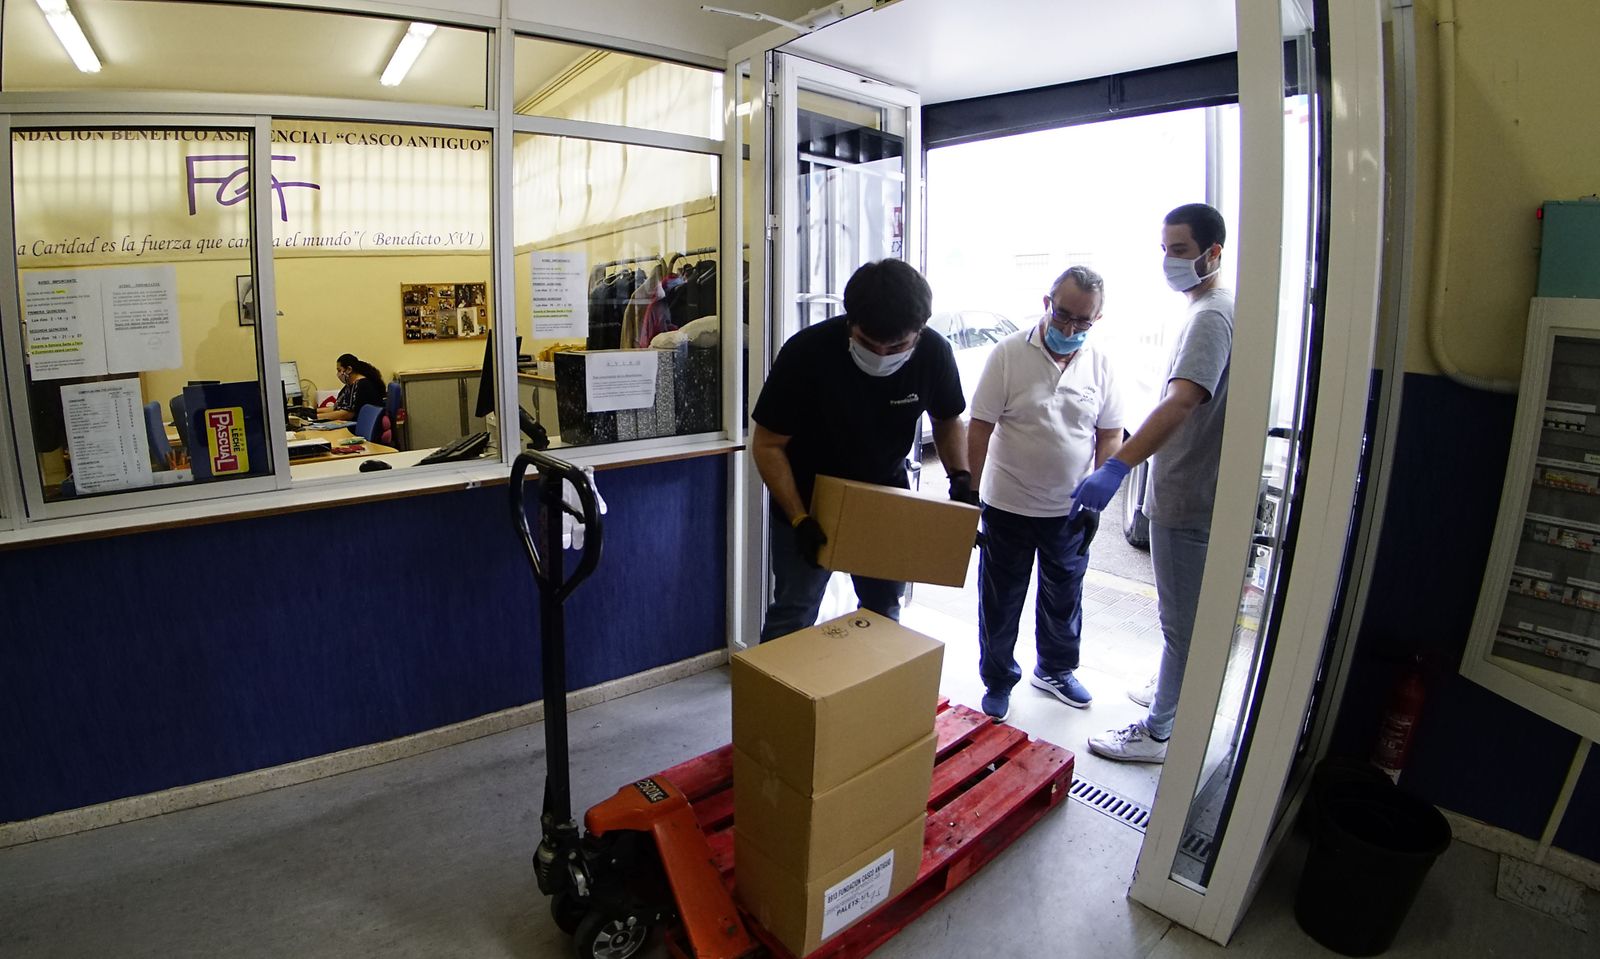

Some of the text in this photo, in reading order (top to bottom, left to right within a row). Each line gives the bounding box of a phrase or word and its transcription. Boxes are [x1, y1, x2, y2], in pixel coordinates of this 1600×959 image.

[111, 131, 207, 141] BENEFICO
[32, 237, 100, 257] Caridad
[101, 242, 116, 253] es
[121, 235, 135, 253] la
[137, 234, 191, 257] fuerza
[196, 239, 223, 255] que
[286, 232, 301, 247] el
[372, 231, 441, 246] Benedicto
[211, 413, 235, 470] PASCUAL
[231, 428, 241, 452] LECHE
[862, 868, 875, 882] CASCO
